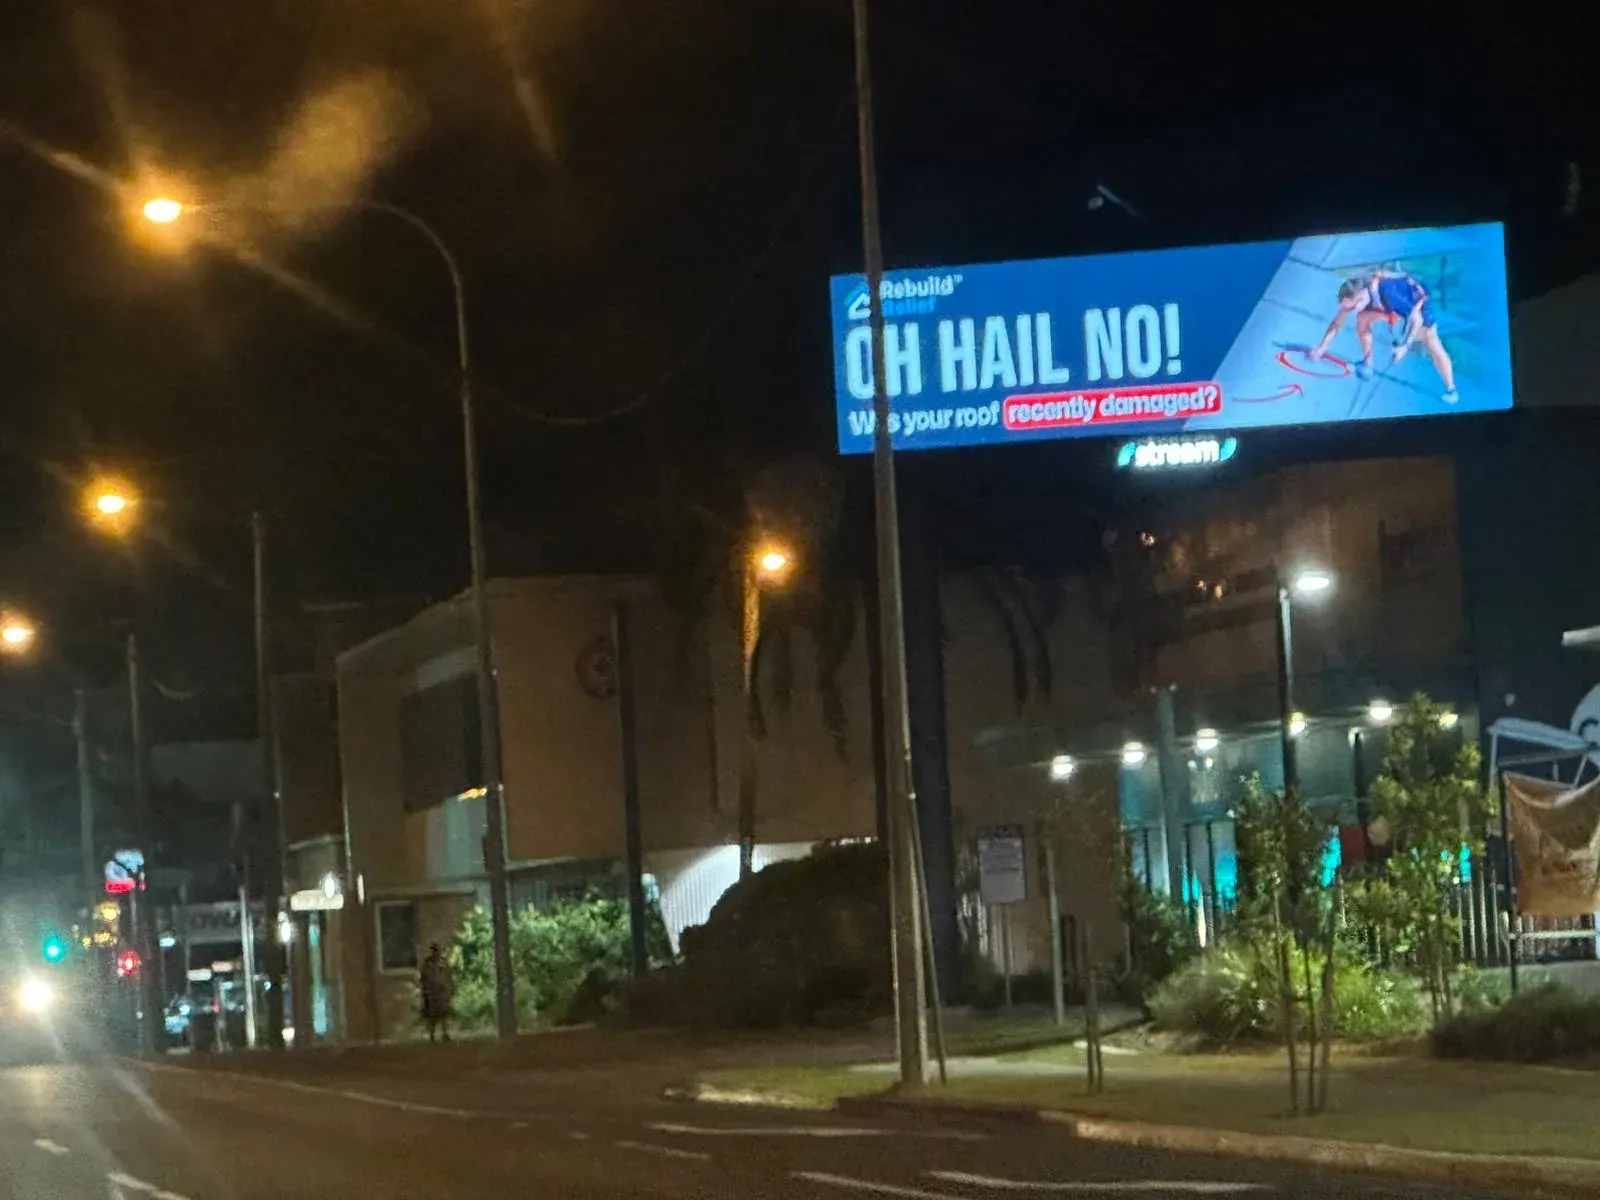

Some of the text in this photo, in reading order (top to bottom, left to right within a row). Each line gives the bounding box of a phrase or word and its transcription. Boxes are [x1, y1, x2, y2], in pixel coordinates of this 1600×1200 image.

[845, 303, 1181, 399] OH HAIL NO!
[848, 386, 1218, 436] Ws your roof recently damaged?
[1134, 438, 1220, 467] stream
